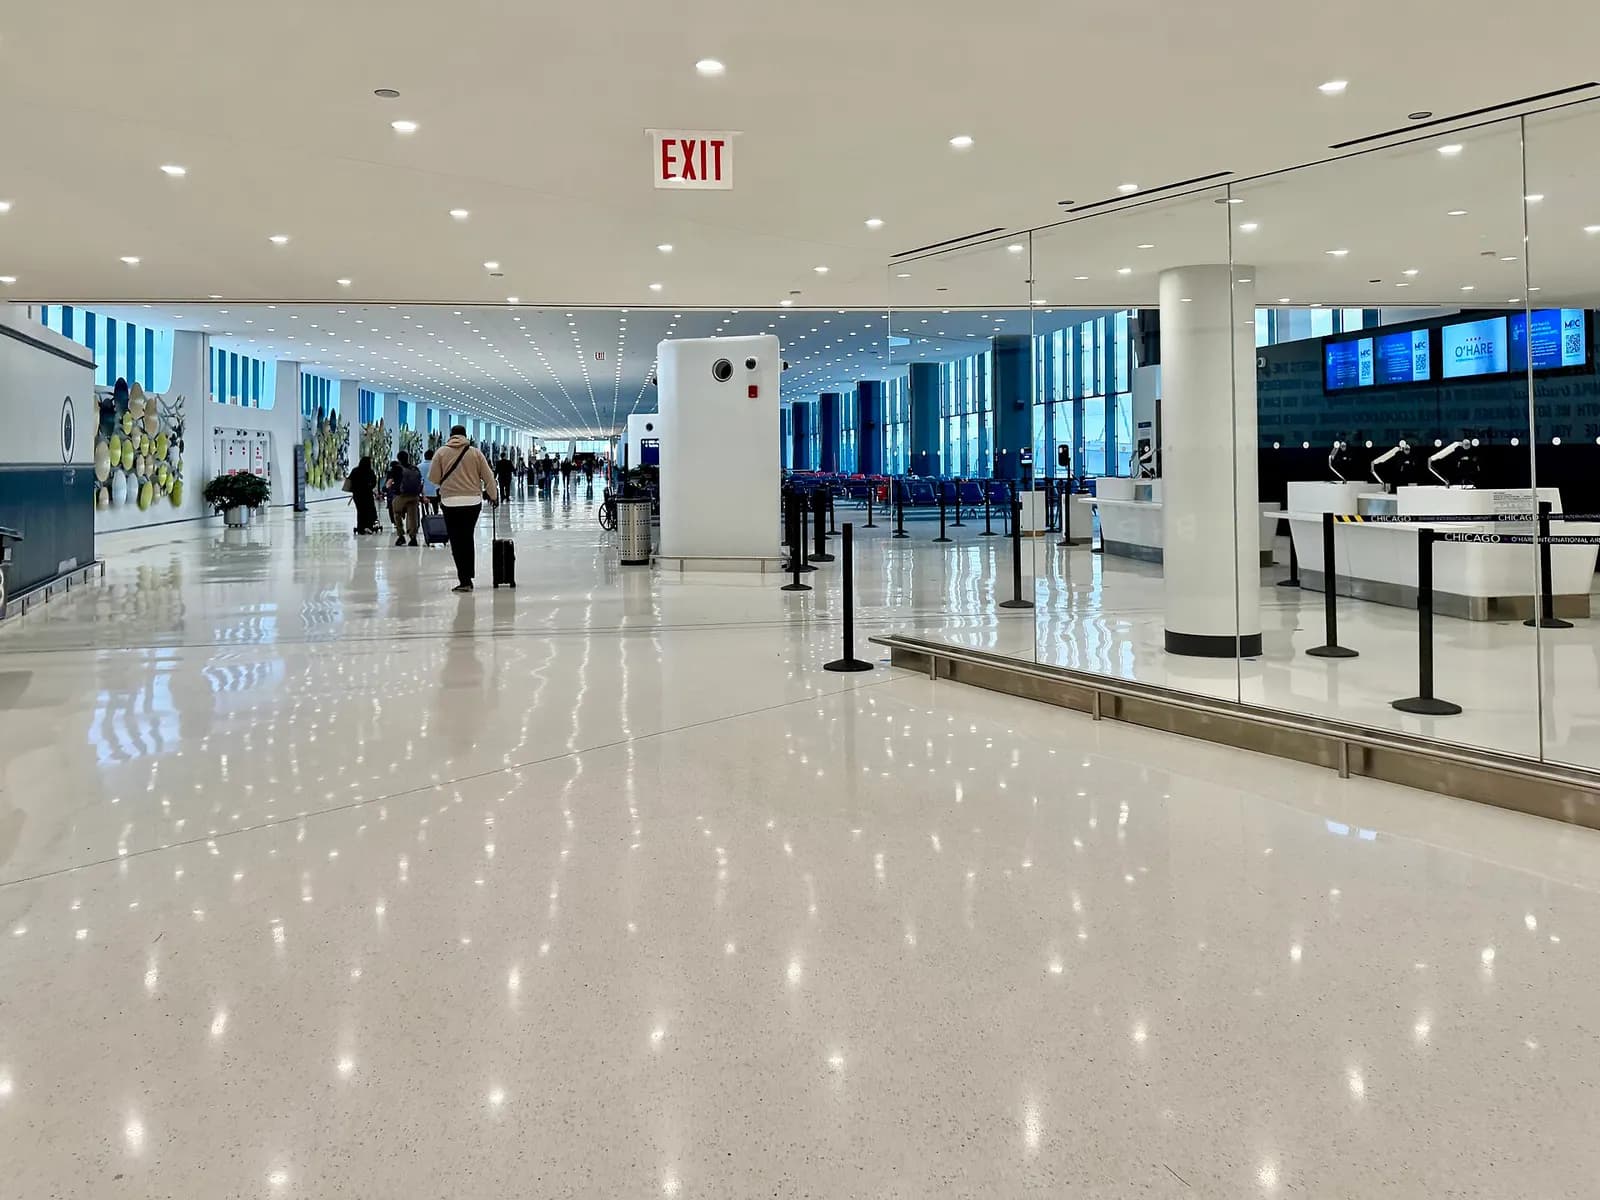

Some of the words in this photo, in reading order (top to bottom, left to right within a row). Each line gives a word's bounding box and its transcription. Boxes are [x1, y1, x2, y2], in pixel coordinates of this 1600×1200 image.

[662, 139, 724, 180] EXIT
[1455, 342, 1493, 358] O'HARE
[1444, 533, 1500, 543] CHICAGO
